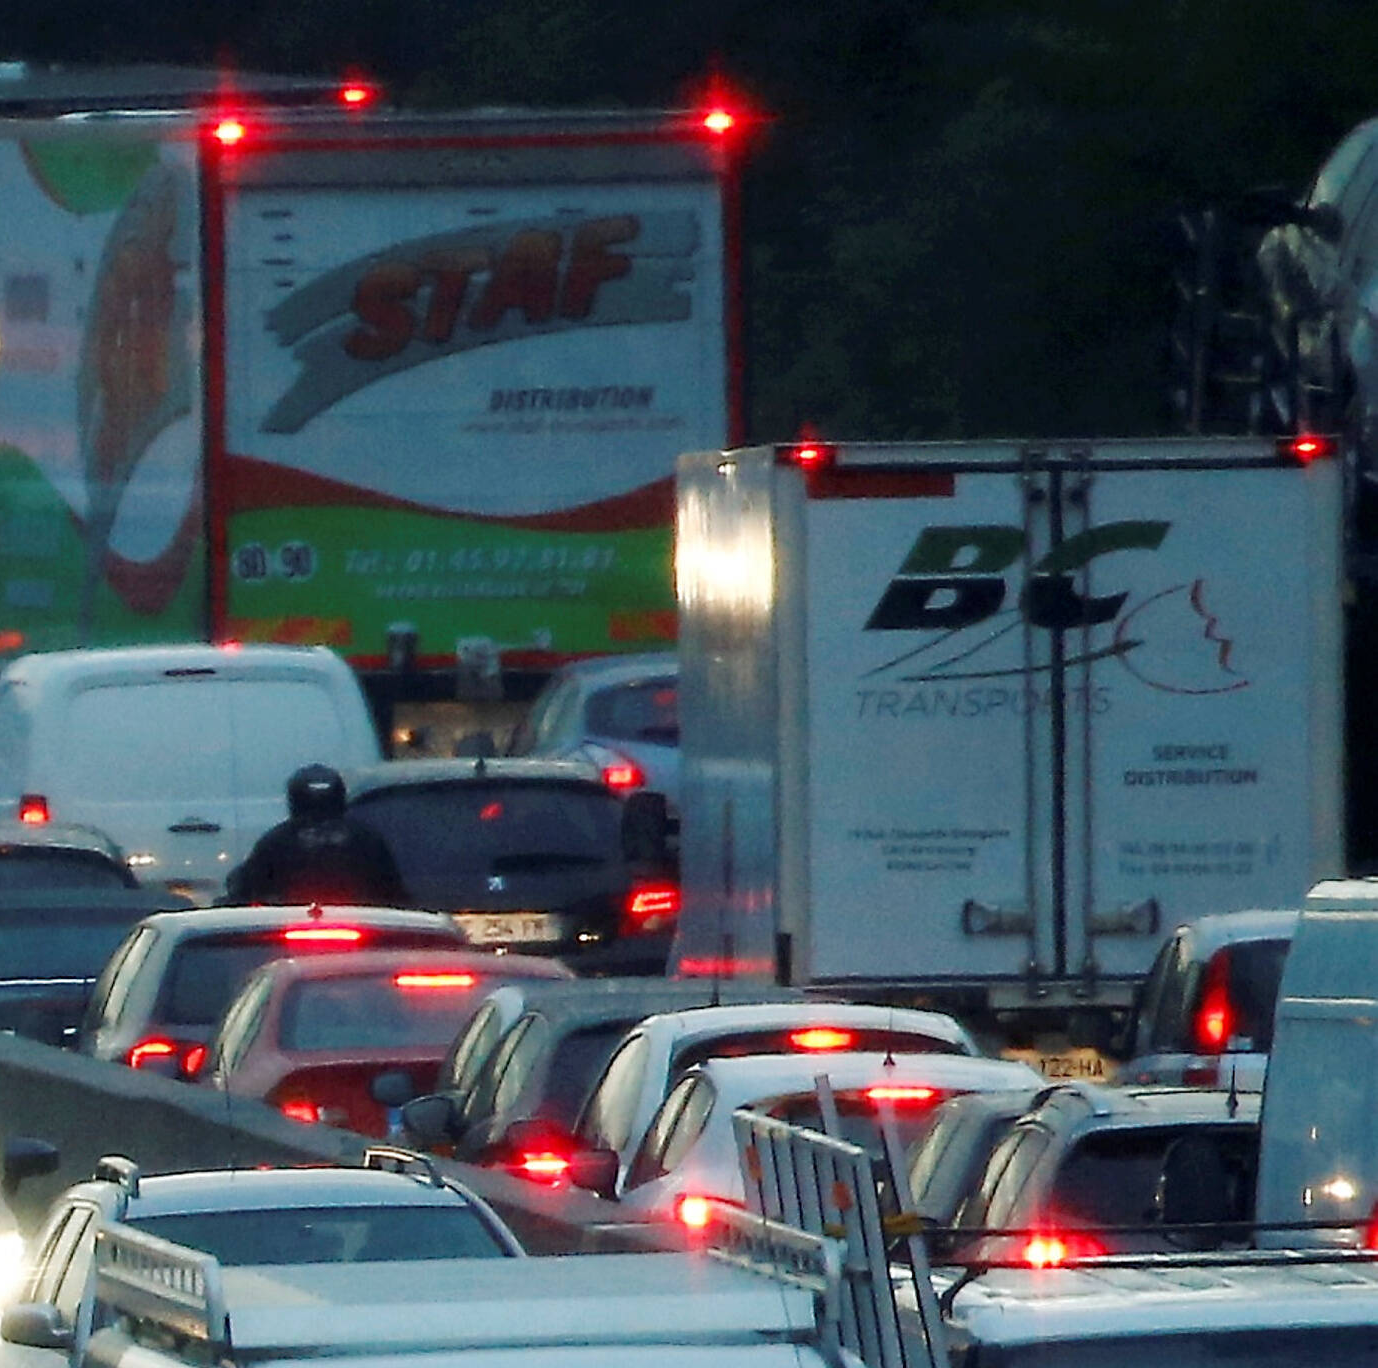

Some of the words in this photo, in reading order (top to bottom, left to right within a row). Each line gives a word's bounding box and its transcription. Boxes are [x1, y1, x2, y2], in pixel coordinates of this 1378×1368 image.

[345, 213, 641, 362] STAF
[489, 385, 656, 412] DISTRIBUTION
[1152, 744, 1229, 761] SERVICE
[1123, 769, 1258, 786] DISTRIBUTION
